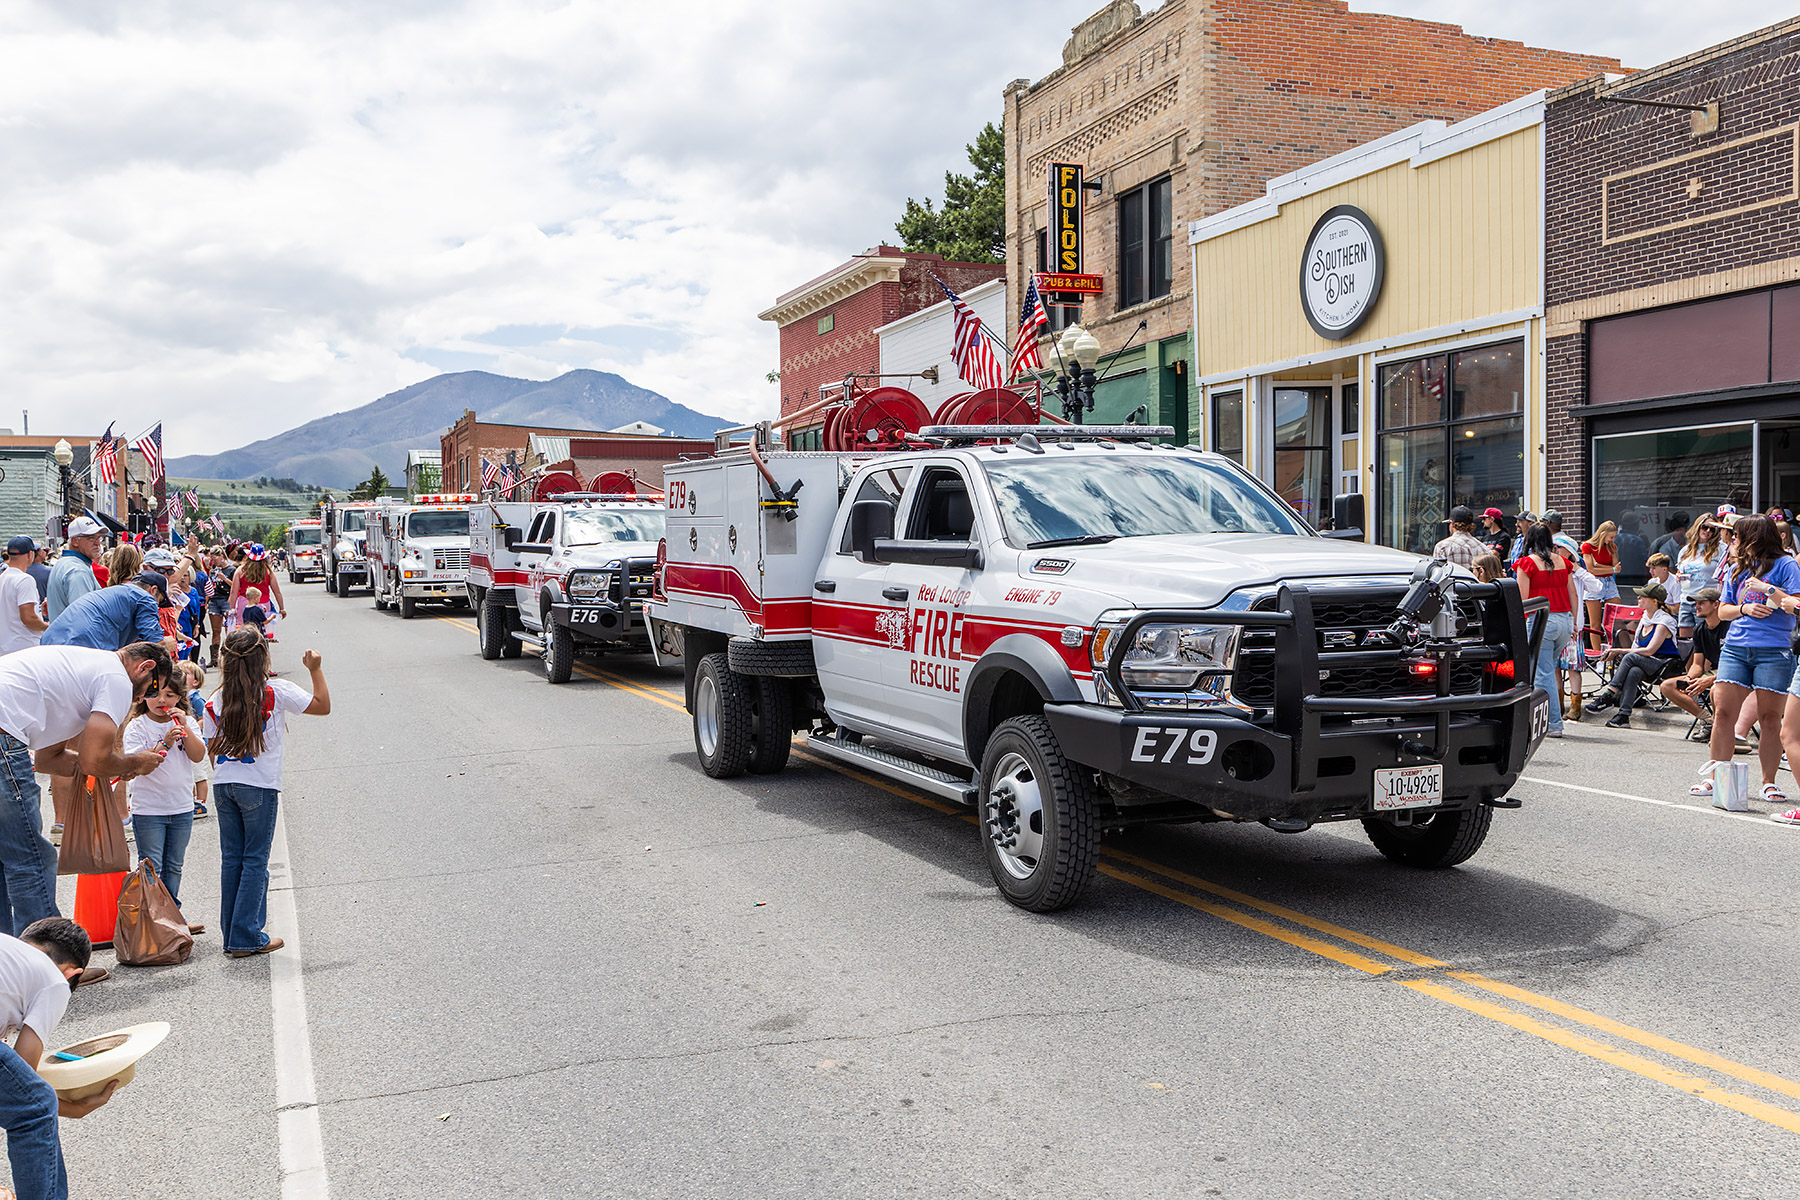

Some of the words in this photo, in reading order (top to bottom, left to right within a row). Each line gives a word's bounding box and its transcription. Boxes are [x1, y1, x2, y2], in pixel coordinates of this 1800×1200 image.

[1061, 167, 1077, 271] FOLOS
[1339, 229, 1349, 237] 2021
[1312, 242, 1367, 281] SOUTHERN
[1043, 277, 1064, 286] PUB
[1074, 278, 1101, 288] GRILL
[1325, 272, 1355, 305] DISH
[1319, 308, 1339, 321] KITCHEN
[1346, 300, 1360, 317] HOME
[669, 481, 686, 509] E79
[918, 584, 938, 602] Red
[939, 586, 971, 608] Lodge
[1004, 588, 1044, 604] ENGINE
[1043, 590, 1062, 606] 79
[570, 609, 599, 624] E76
[911, 608, 965, 660] FIRE
[910, 658, 960, 694] RESCUE
[1532, 699, 1549, 741] E79
[1130, 726, 1218, 765] E79
